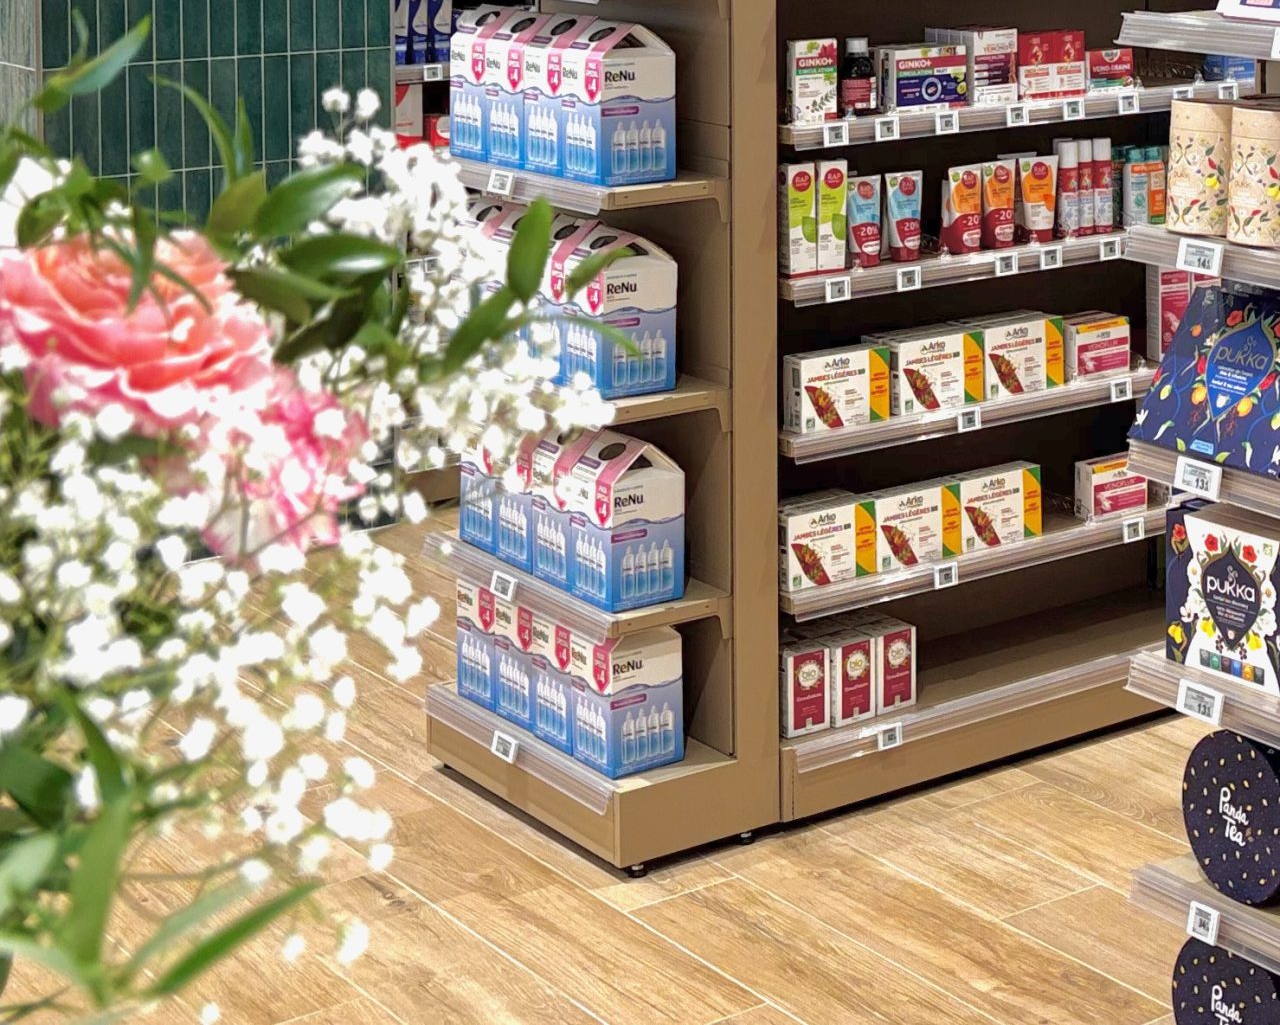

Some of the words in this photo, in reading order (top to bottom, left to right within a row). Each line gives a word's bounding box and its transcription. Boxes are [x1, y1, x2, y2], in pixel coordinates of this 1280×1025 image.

[604, 69, 636, 83] ReNu
[606, 281, 638, 296] ReNu
[1213, 346, 1270, 371] pukka
[613, 492, 645, 509] ReNu
[1206, 575, 1256, 603] pukka
[613, 658, 643, 675] ReNu
[1218, 787, 1250, 827] Panda
[1223, 815, 1248, 848] Tea
[1211, 984, 1243, 1023] Panda
